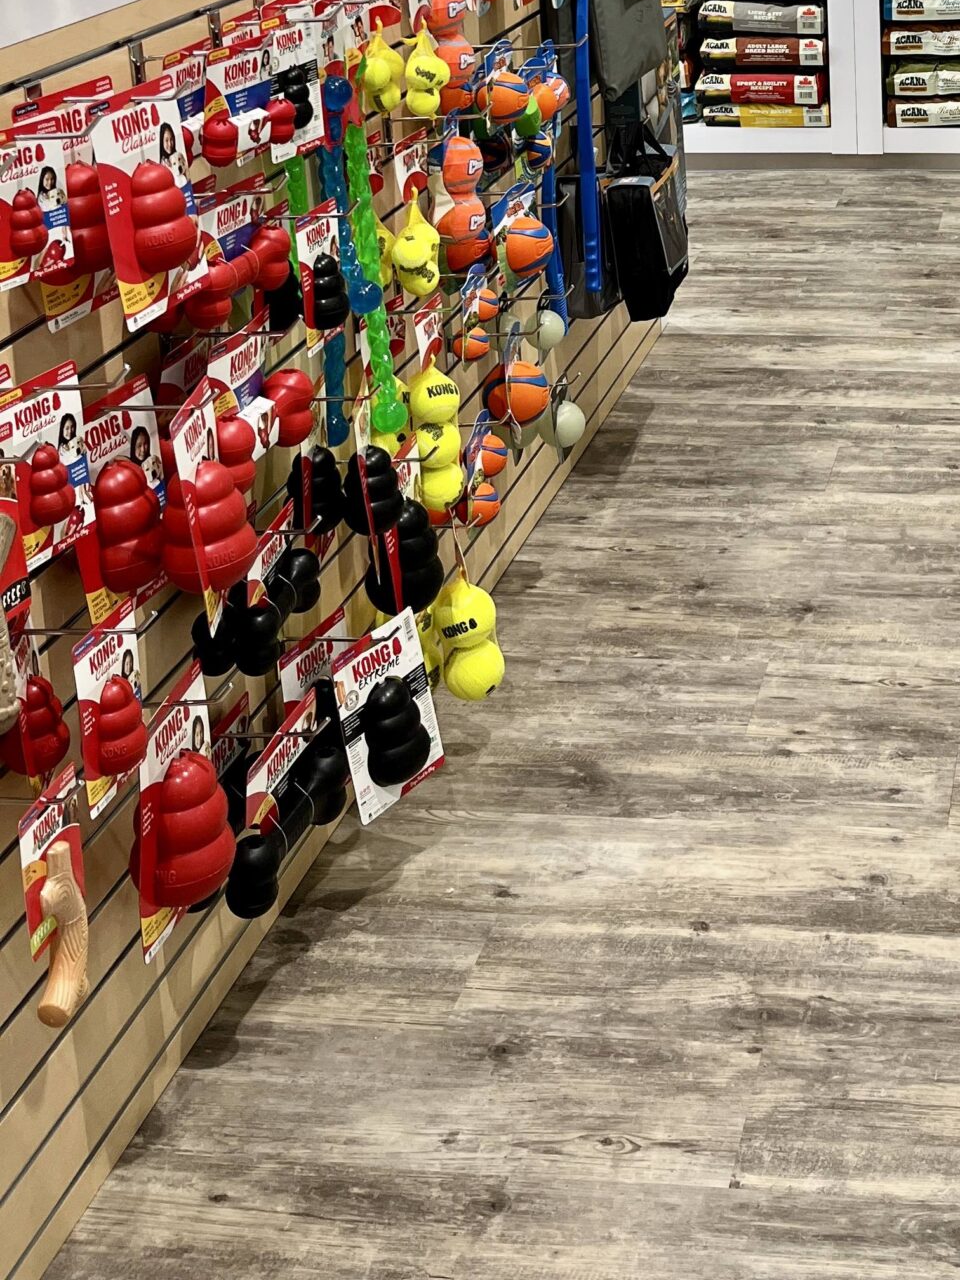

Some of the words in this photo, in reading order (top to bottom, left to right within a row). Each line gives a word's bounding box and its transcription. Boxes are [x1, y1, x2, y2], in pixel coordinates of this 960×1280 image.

[702, 4, 727, 13] ACANA
[896, 0, 924, 9] ACANA
[276, 30, 297, 49] KONG
[279, 44, 302, 56] EXTREME
[895, 34, 923, 44] ACANA
[224, 61, 251, 83] KONG
[701, 76, 724, 84] ACANA
[899, 77, 927, 87] ACANA
[709, 106, 734, 114] ACANA
[901, 106, 928, 117] ACANA
[112, 108, 152, 143] KONG
[122, 130, 157, 155] Classic
[0, 166, 39, 183] Classic
[217, 205, 240, 228] KONG
[306, 222, 327, 247] KONG
[308, 237, 329, 255] EXTREME
[230, 339, 254, 377] KONG
[427, 383, 453, 398] KONG
[14, 398, 51, 424] KONG
[22, 415, 57, 438] Classic
[84, 414, 121, 452] KONG
[184, 417, 202, 453] KONG
[90, 436, 129, 463] Classic
[442, 622, 469, 639] KONG
[89, 636, 117, 674] KONG
[94, 653, 121, 681] Classic
[296, 647, 326, 681] KONG
[352, 644, 391, 683] KONG
[300, 655, 331, 689] EXTREME
[358, 655, 401, 690] EXTREME
[154, 708, 183, 759] KONG
[160, 729, 188, 765] Classic
